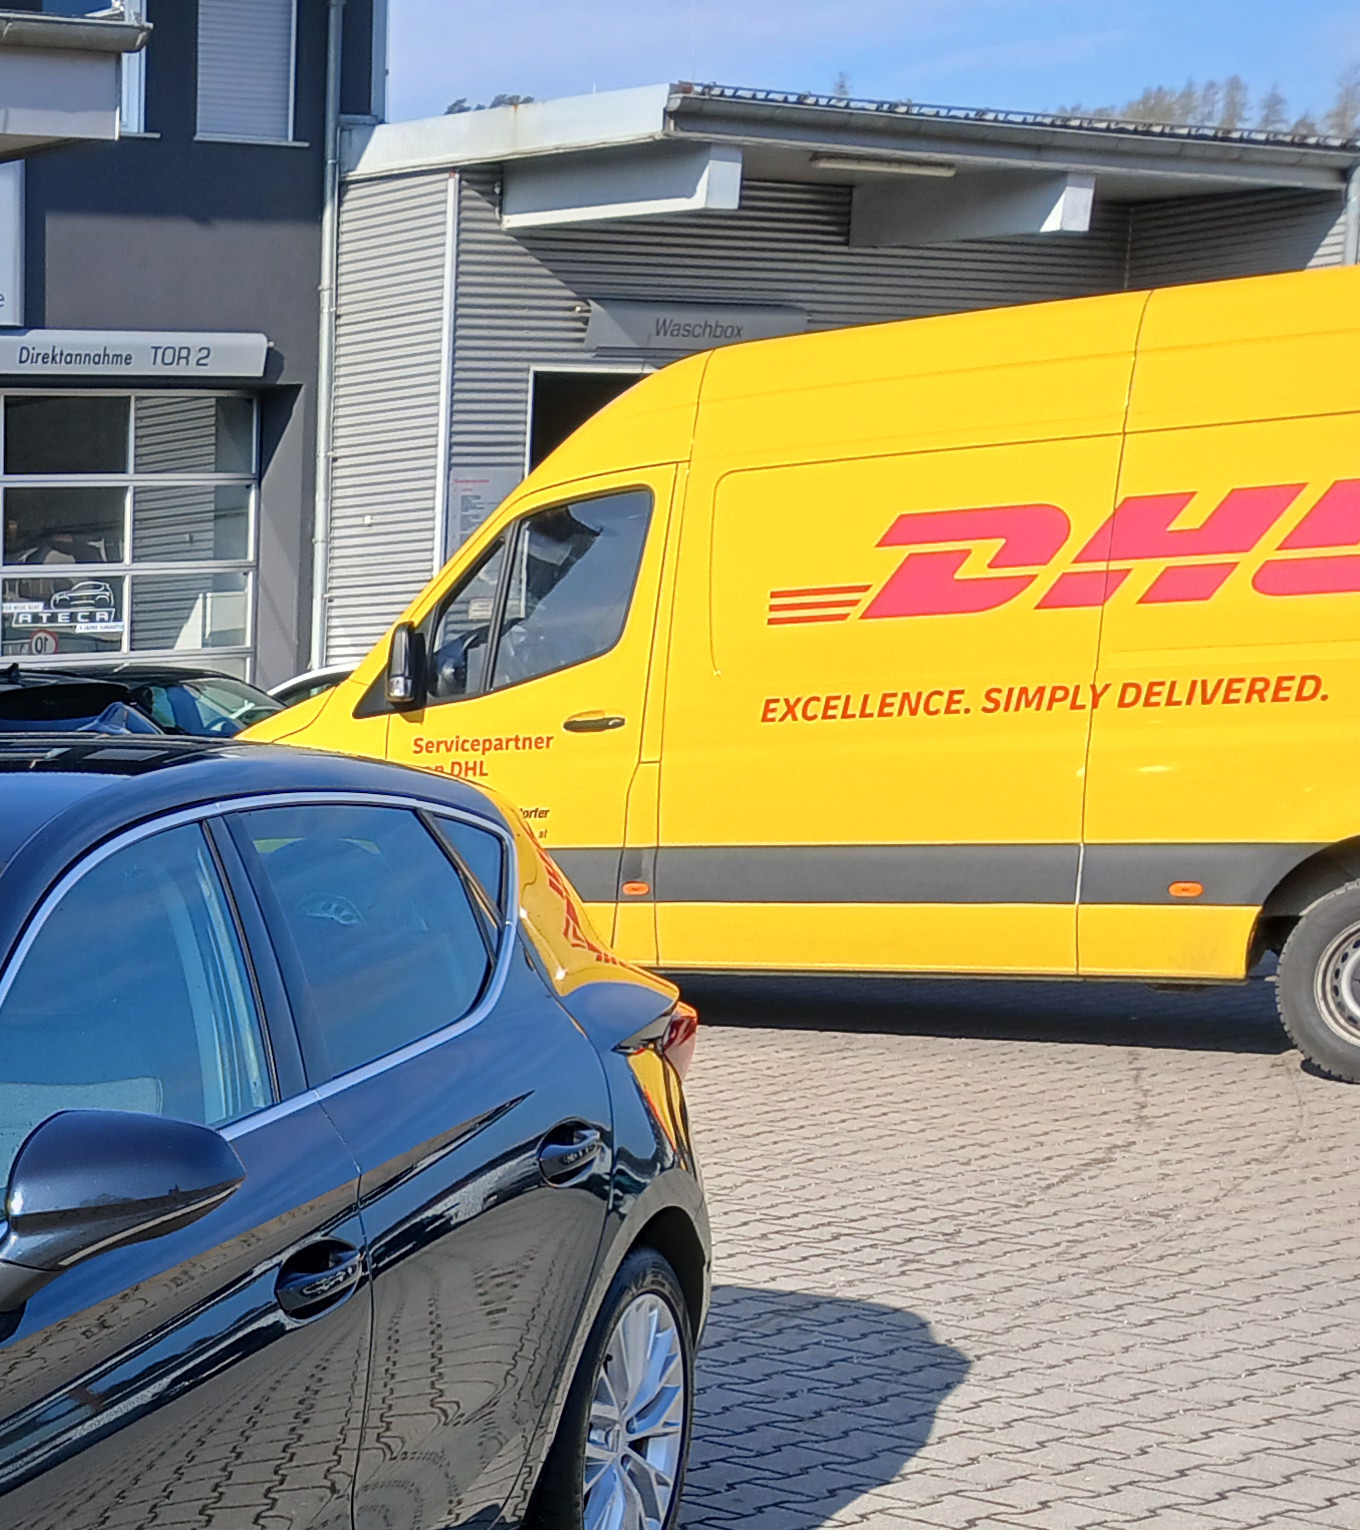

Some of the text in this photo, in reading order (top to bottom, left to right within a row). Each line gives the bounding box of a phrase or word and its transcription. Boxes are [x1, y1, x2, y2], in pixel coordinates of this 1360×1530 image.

[655, 318, 743, 339] Waschbox
[18, 346, 211, 367] Direktannahme TOR 2
[18, 612, 109, 623] ATECA
[760, 674, 1330, 723] EXCELLENCE. SIMPLY DELIVERED.
[413, 735, 554, 755] Servicepartner
[451, 760, 489, 777] DHL
